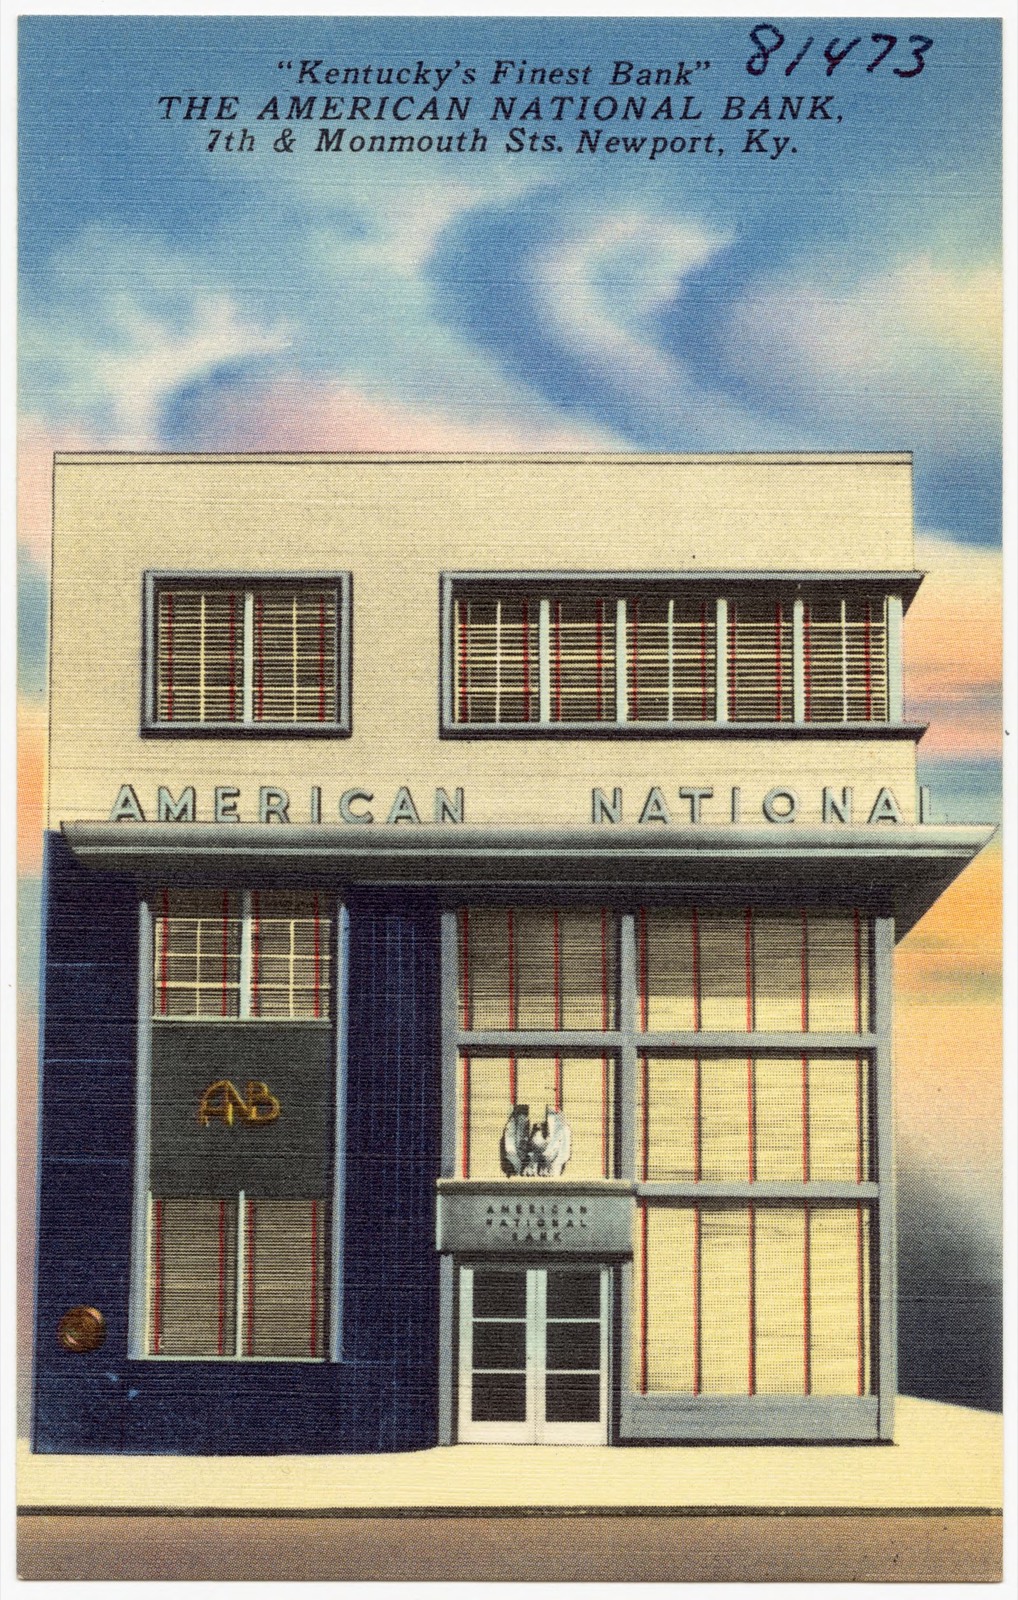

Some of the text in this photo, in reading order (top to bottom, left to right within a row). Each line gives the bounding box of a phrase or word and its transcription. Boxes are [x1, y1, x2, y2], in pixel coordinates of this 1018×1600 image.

[746, 23, 934, 78] 81473
[108, 784, 949, 825] AMERICAN NATIONAL
[486, 1205, 588, 1215] AMERICAN
[485, 1219, 588, 1228] NATIONAL
[512, 1232, 562, 1243] BANK
